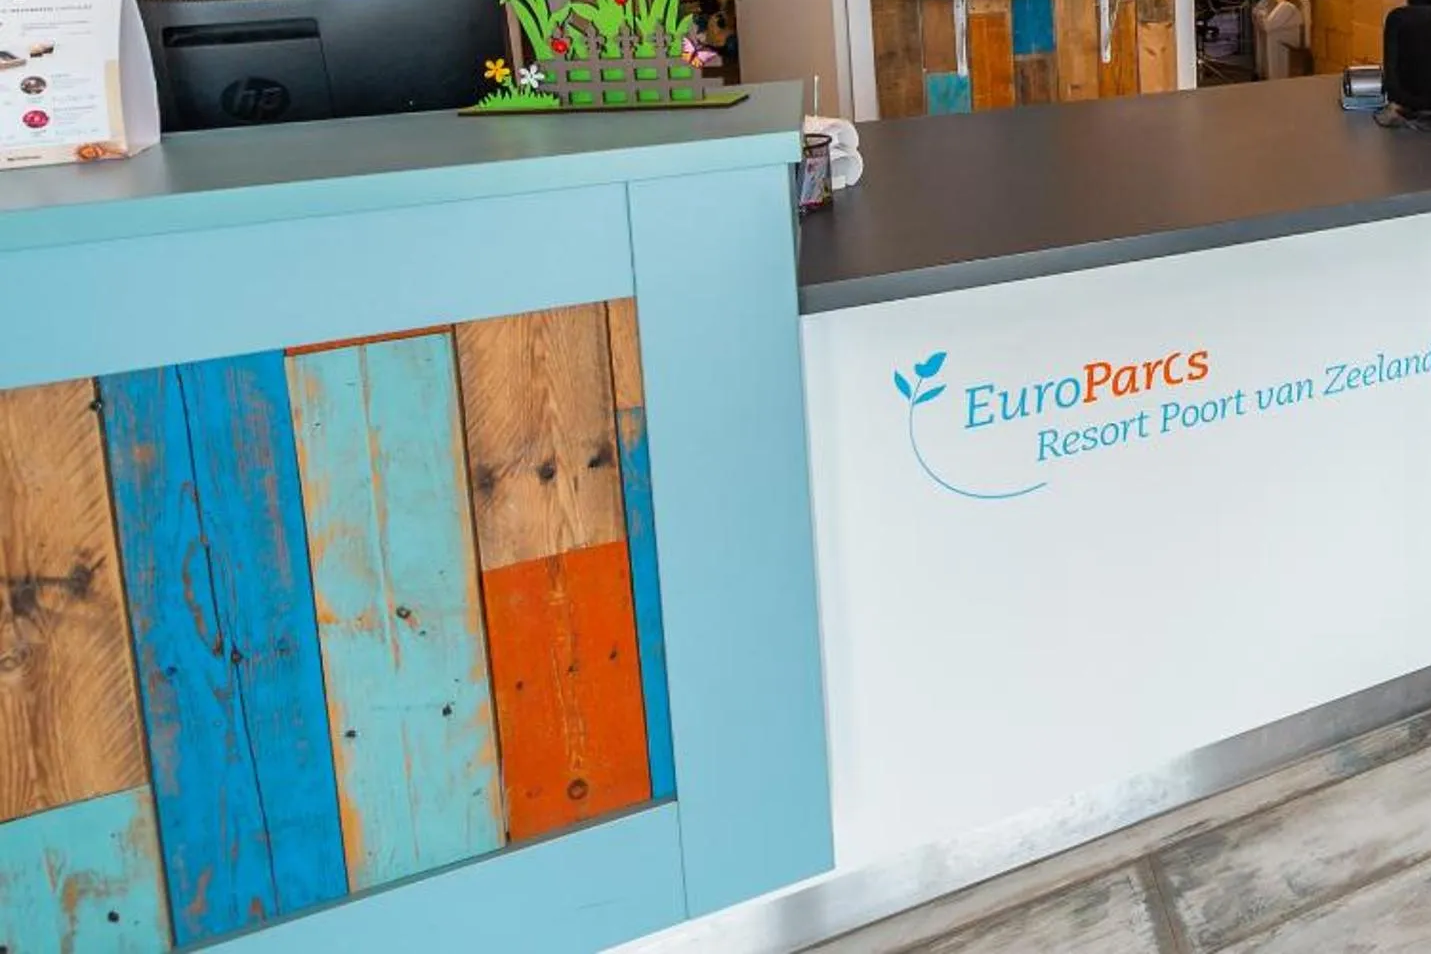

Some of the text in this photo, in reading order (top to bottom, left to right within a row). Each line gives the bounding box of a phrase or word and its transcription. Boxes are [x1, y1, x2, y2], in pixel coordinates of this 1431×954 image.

[964, 349, 1209, 429] EuroParcs
[1036, 410, 1150, 462] Resort
[1160, 388, 1248, 434] Poort
[1255, 377, 1314, 411] van
